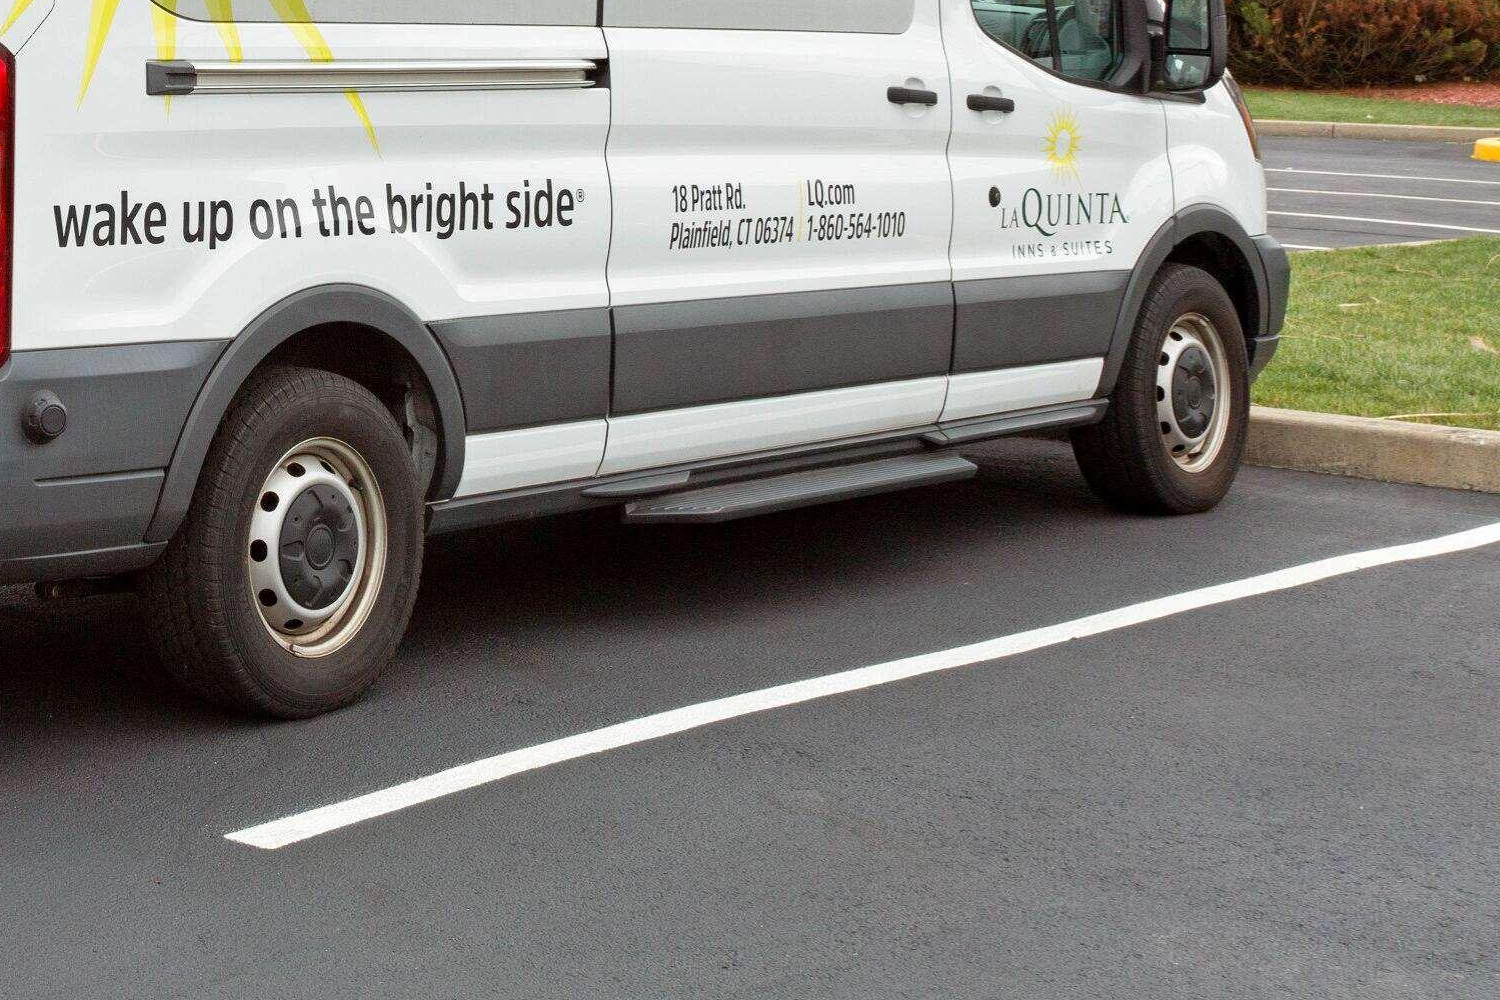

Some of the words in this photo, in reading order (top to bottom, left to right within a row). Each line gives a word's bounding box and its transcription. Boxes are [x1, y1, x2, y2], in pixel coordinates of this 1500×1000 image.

[672, 185, 687, 212] 18
[691, 185, 722, 211] Pratt
[726, 183, 745, 209] Rd.
[808, 180, 854, 208] LQ.com
[54, 191, 166, 247] wake
[183, 200, 233, 249] up
[250, 198, 301, 239] on
[312, 186, 375, 237] the
[386, 182, 493, 239] bright
[808, 212, 905, 241] 1-860-564-1010
[670, 220, 732, 249] Plainfield,
[737, 219, 752, 245] CT
[755, 217, 793, 244] 06374
[1012, 242, 1044, 258] INNS
[1063, 240, 1113, 257] SUITES
